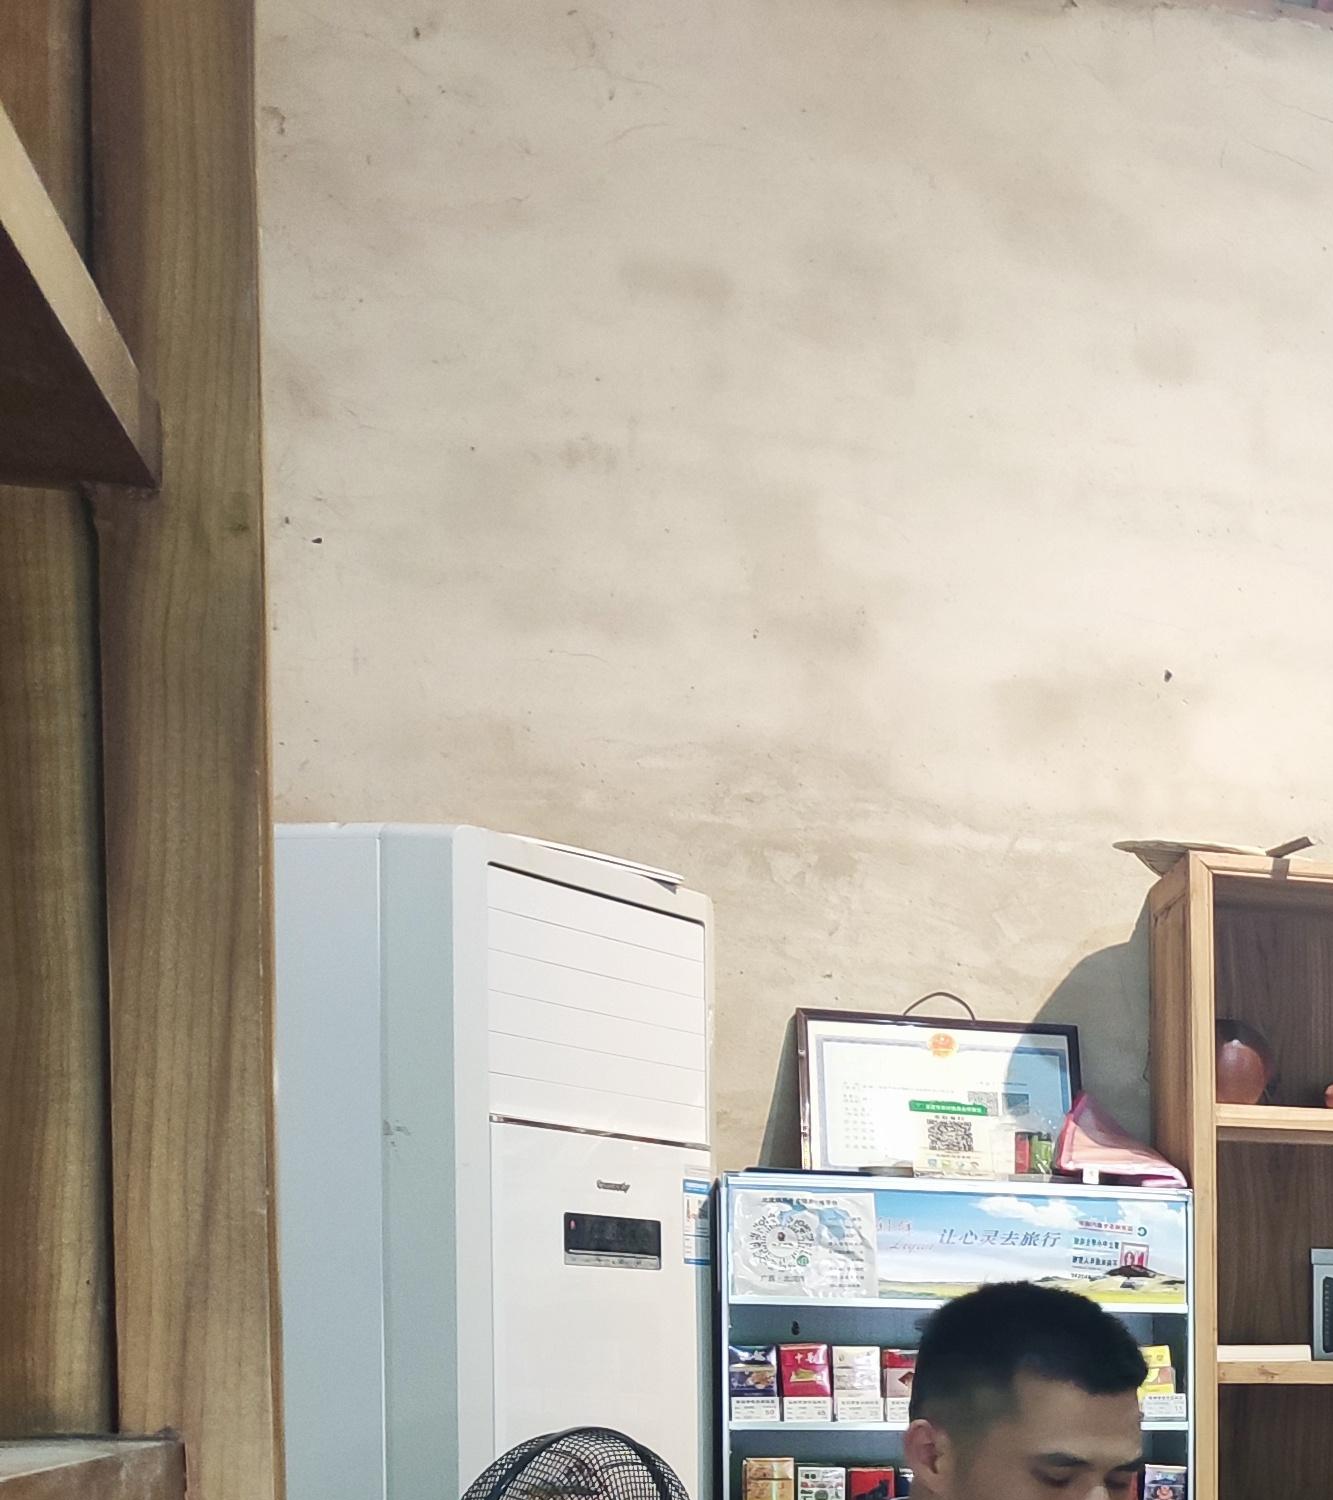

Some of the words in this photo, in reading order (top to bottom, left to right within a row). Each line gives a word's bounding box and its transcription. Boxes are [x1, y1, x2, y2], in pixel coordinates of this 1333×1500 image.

[938, 1228, 1062, 1248] 让心灵去旅行
